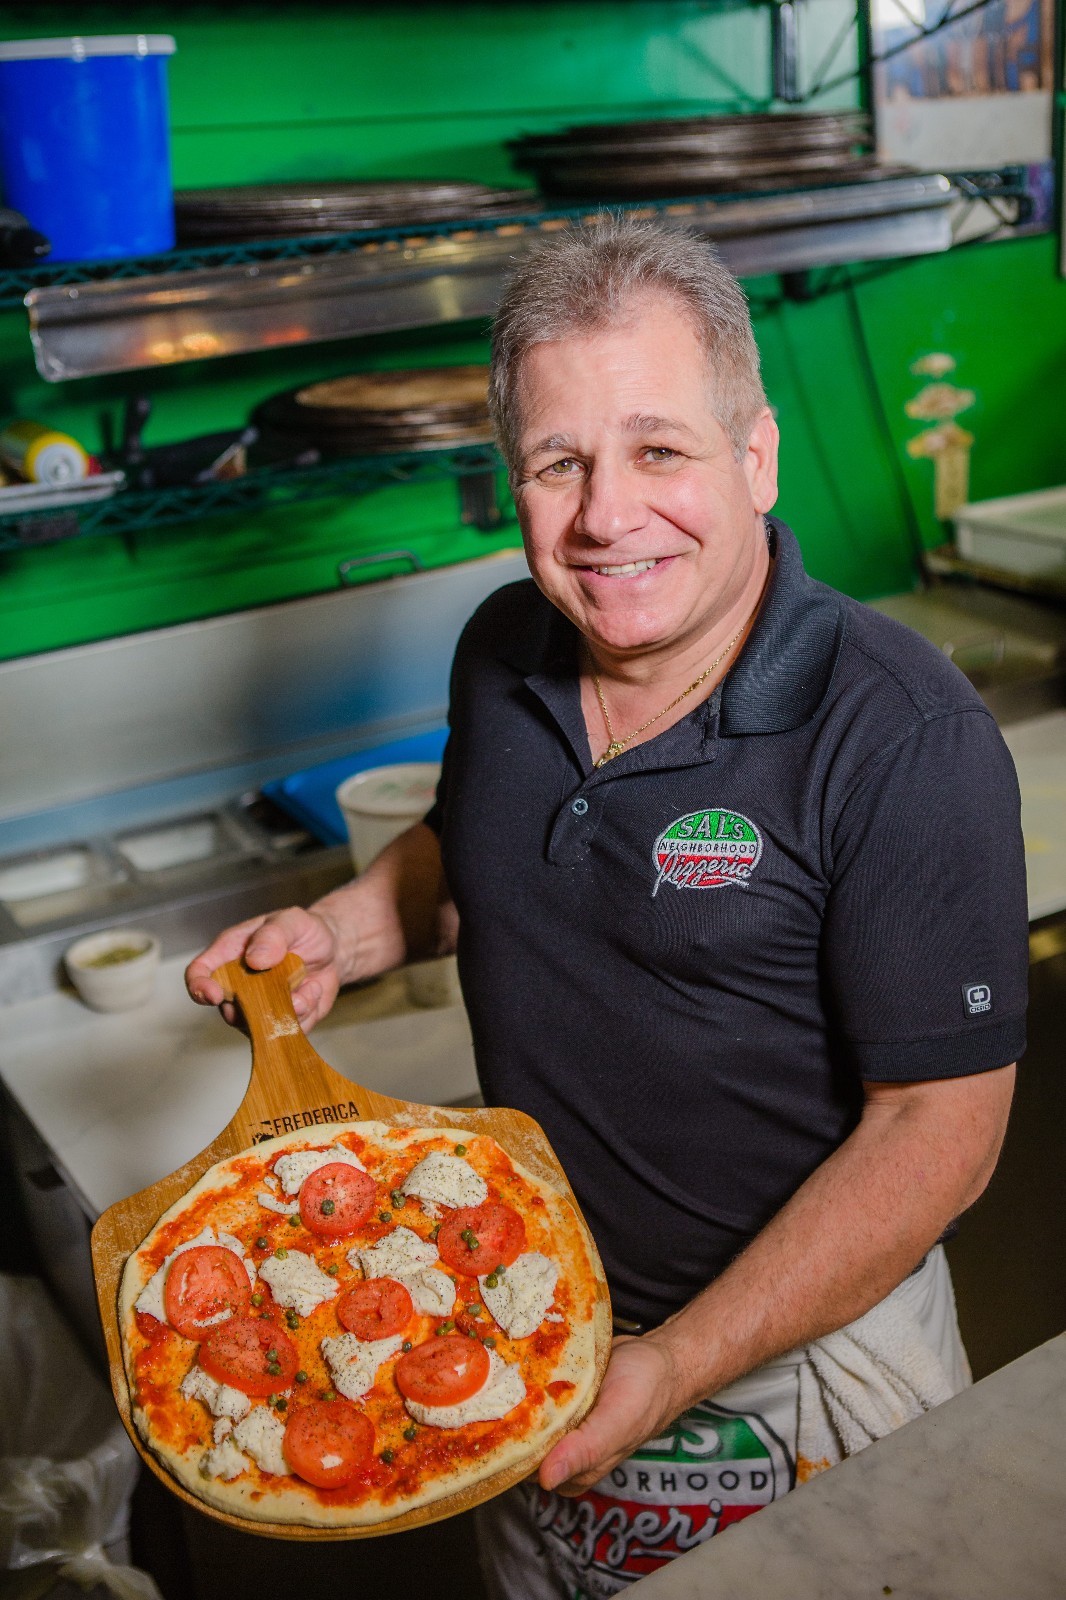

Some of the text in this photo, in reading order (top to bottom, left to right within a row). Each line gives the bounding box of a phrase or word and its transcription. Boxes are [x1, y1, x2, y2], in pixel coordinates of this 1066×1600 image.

[659, 841, 756, 854] NEIGHBORHOOD
[651, 849, 752, 898] Pizzeria
[272, 1101, 359, 1135] FREDERICA
[610, 1468, 769, 1493] ORHOOD
[528, 1488, 724, 1567] izzeri
